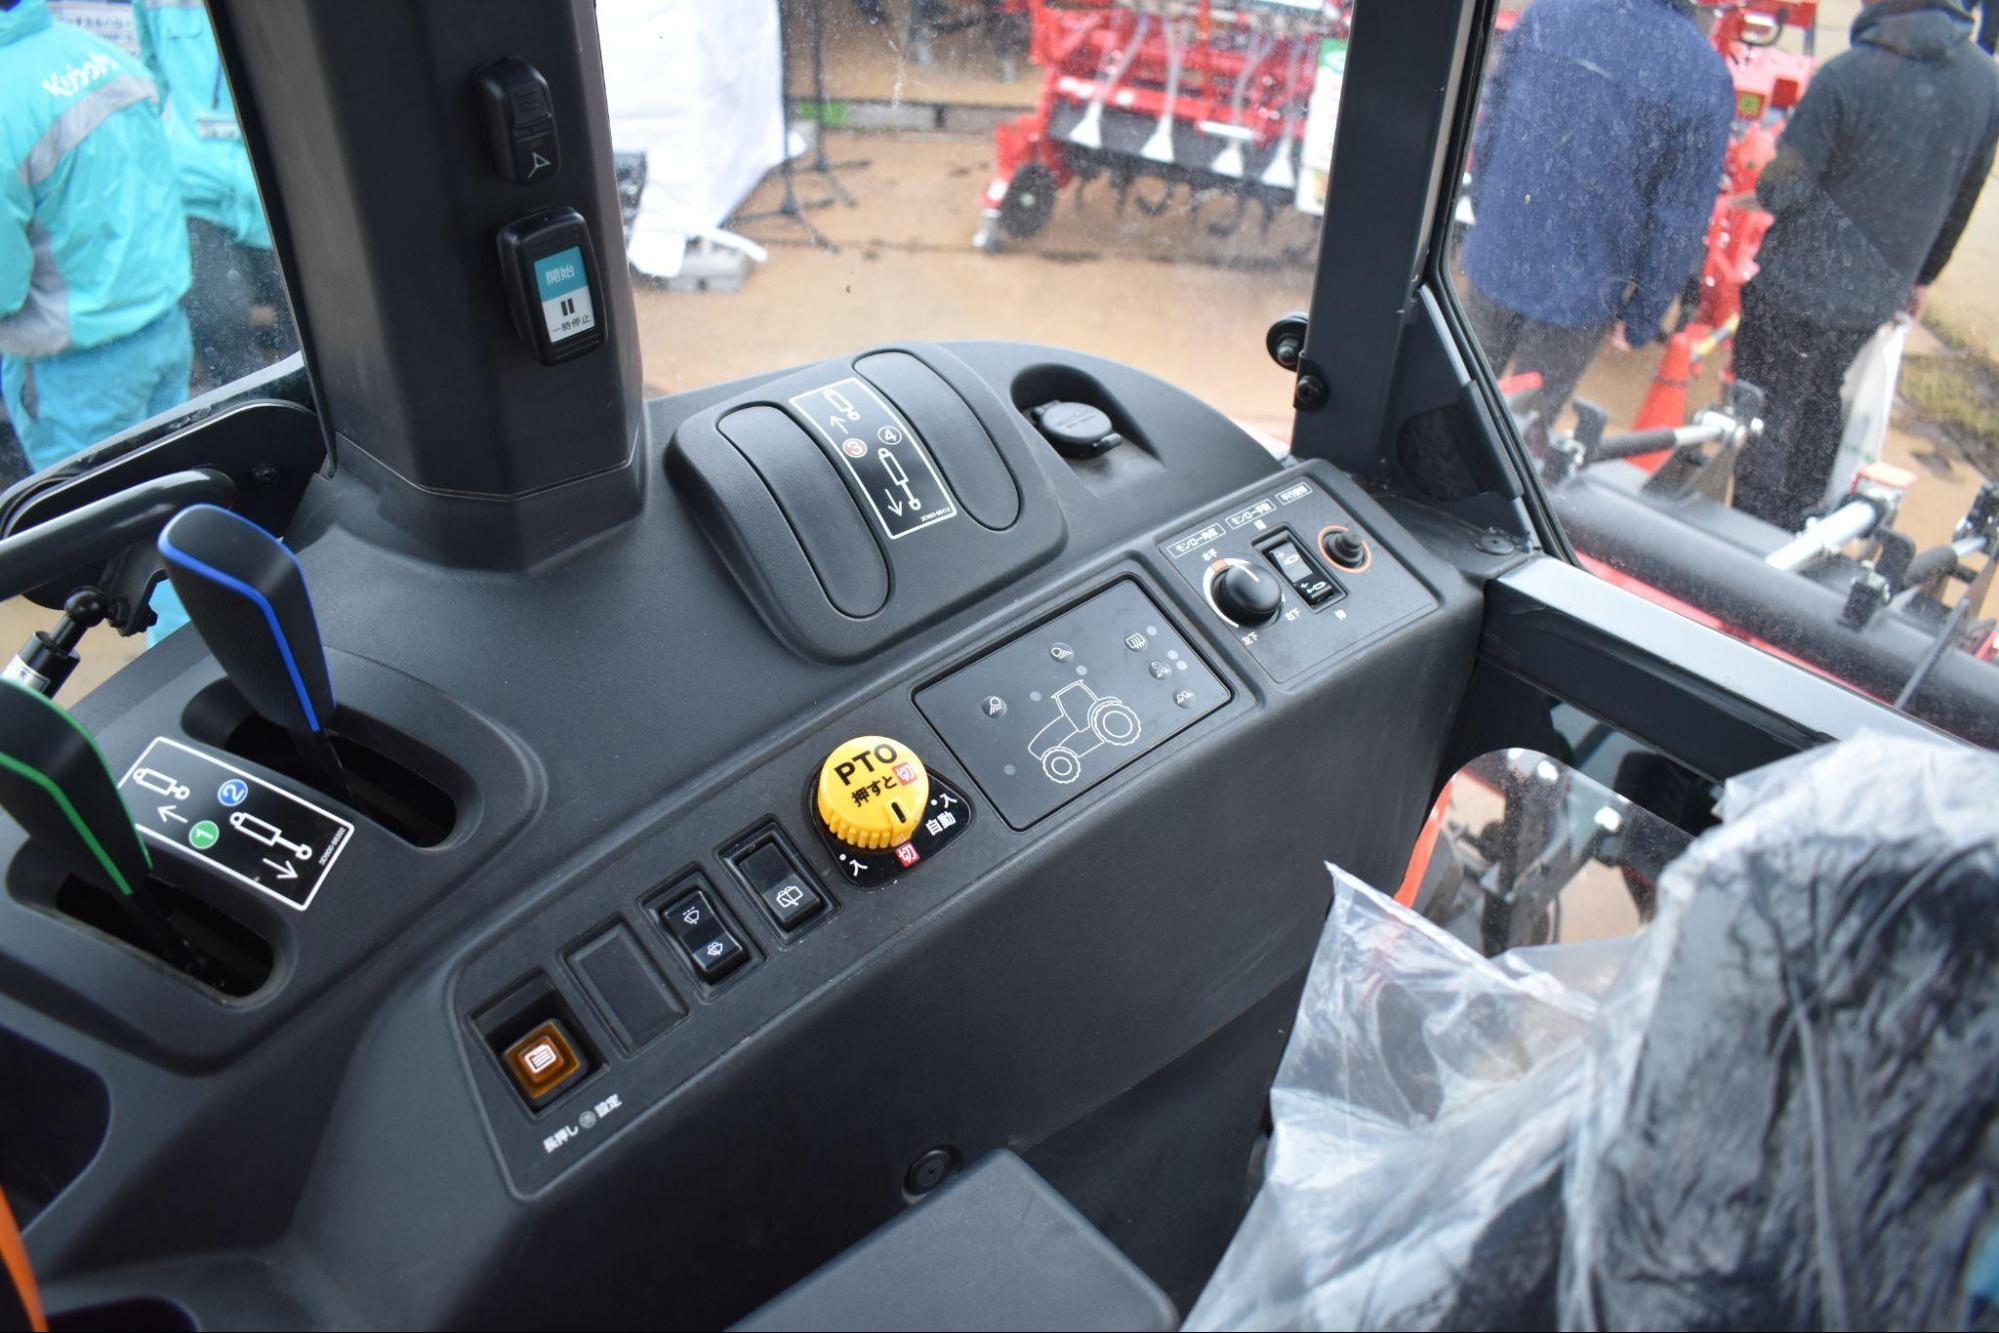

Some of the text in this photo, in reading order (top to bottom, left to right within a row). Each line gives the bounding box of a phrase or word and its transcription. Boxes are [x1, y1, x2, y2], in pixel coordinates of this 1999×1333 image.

[40, 48, 120, 97] Kubota
[545, 264, 576, 286] 開始
[551, 314, 593, 332] 一時停止
[1241, 631, 1258, 646] 左下
[834, 744, 898, 786] PTO
[939, 793, 958, 809] 入
[925, 810, 957, 836] 自動
[896, 842, 919, 866] 切
[849, 859, 869, 877] 入
